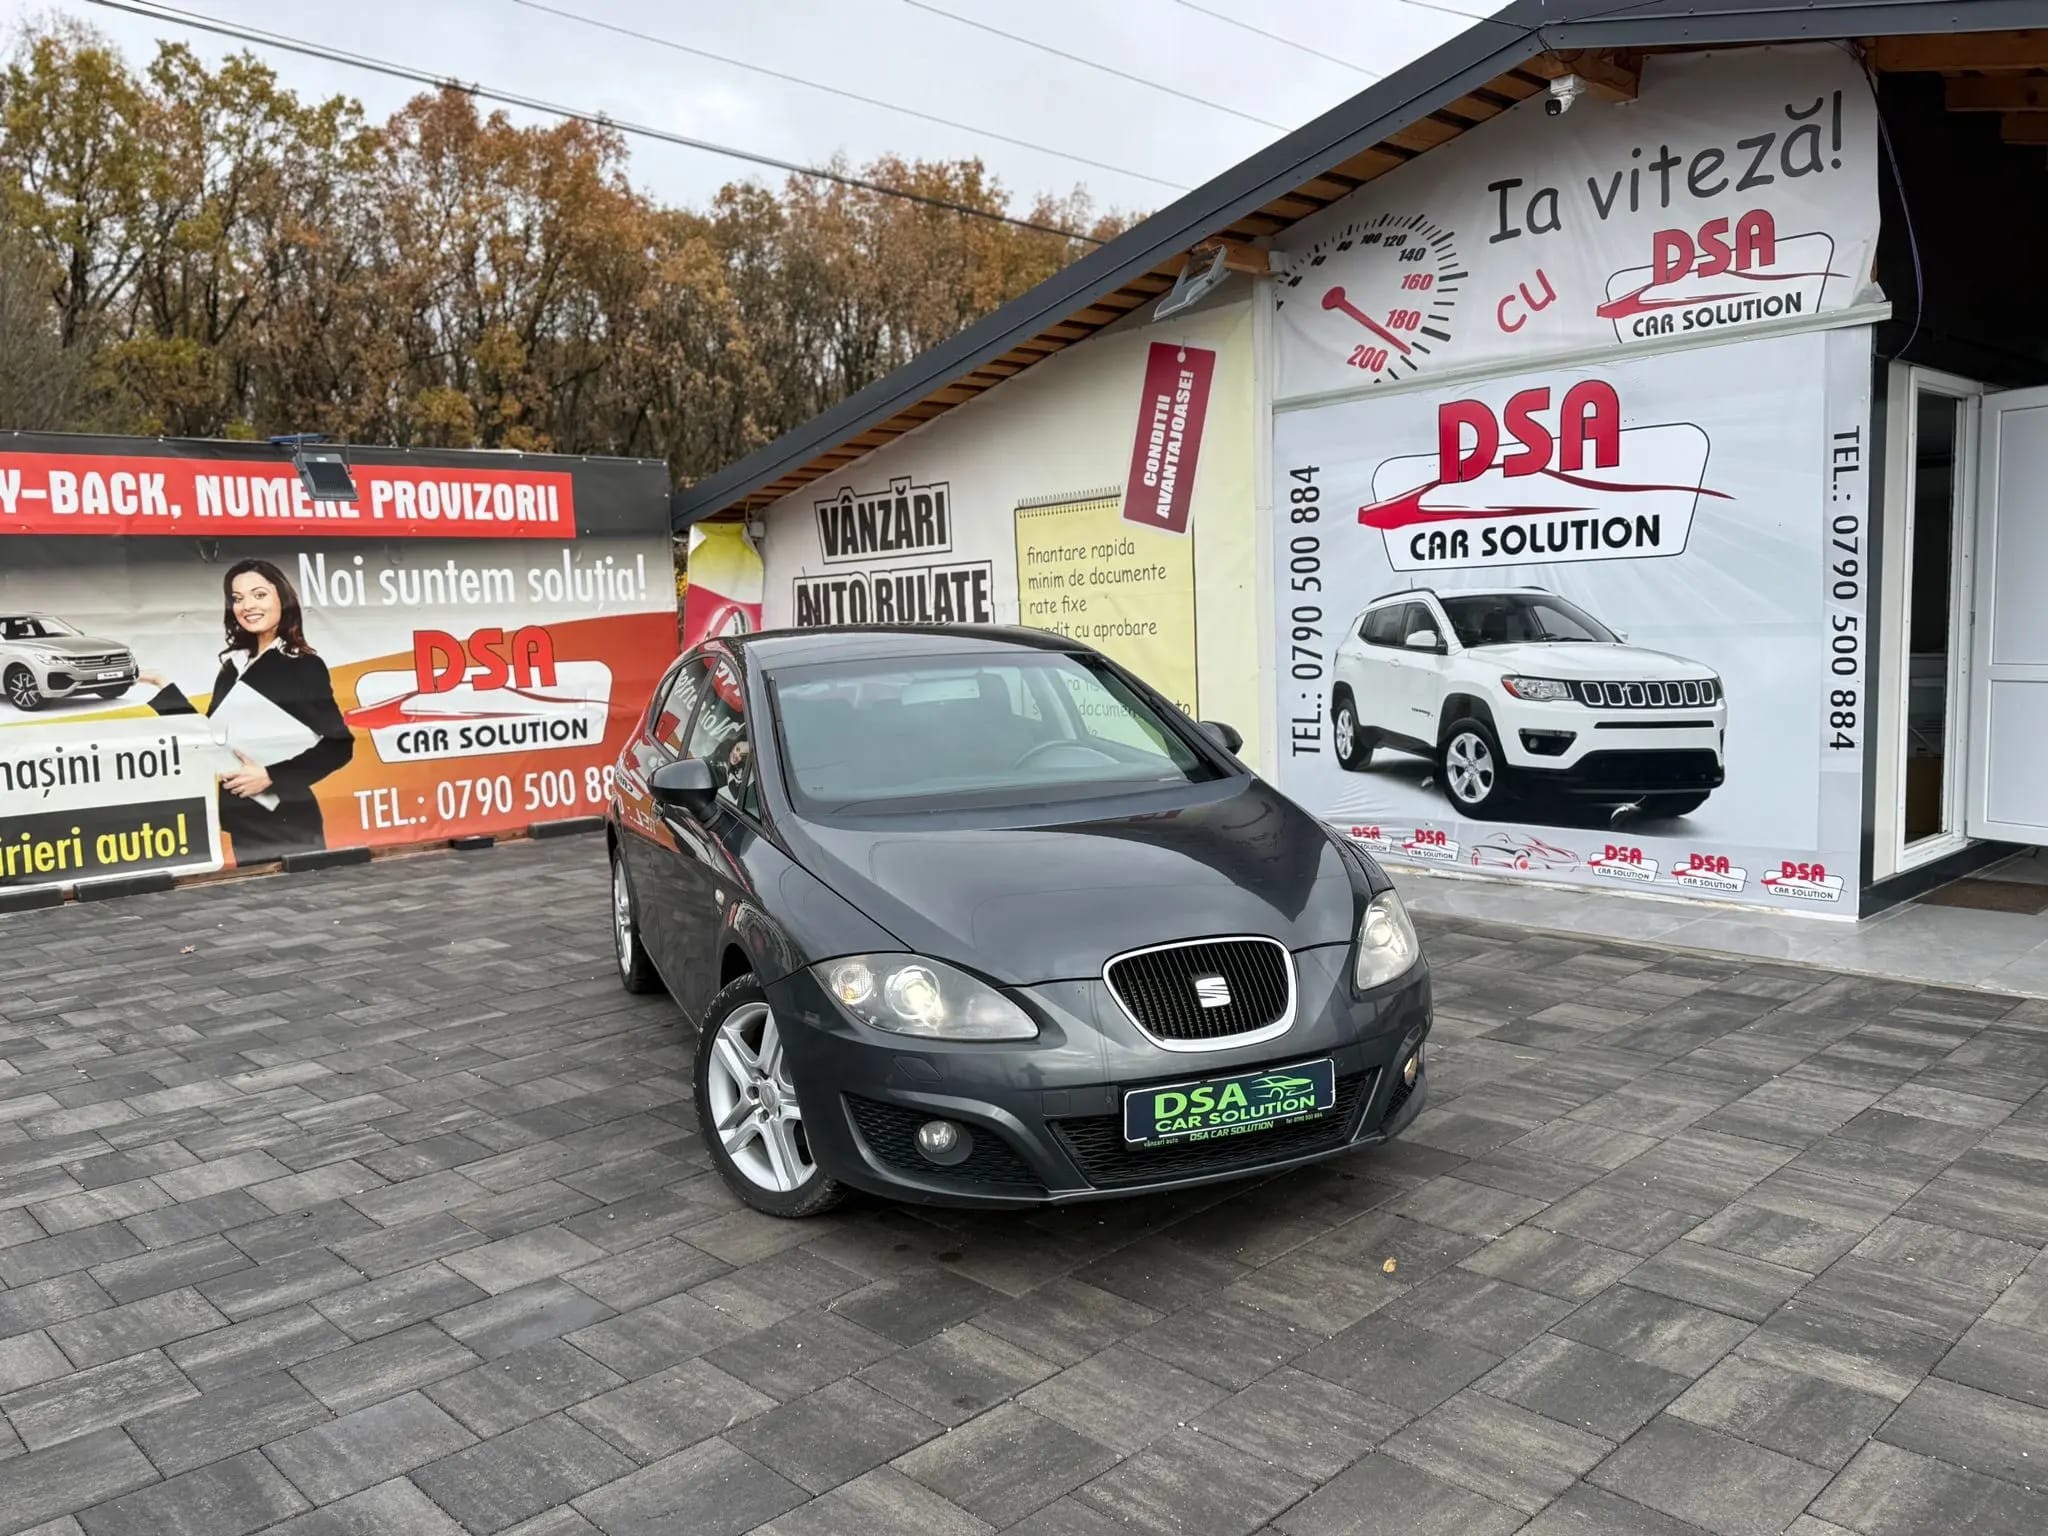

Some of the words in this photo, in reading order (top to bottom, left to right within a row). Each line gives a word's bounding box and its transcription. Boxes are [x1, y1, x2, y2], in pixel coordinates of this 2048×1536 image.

[1488, 178, 1561, 243] Ia
[1587, 90, 1842, 220] viteză!
[1360, 232, 1383, 245] 100
[1382, 234, 1408, 247] 120
[1398, 247, 1427, 262] 140
[1653, 209, 1775, 286] DSA
[1400, 273, 1434, 291] 160
[1497, 269, 1556, 333] cu
[1385, 309, 1421, 331] 180
[1632, 311, 1674, 338] CAR
[1682, 291, 1802, 330] SOLUTION
[1346, 344, 1389, 373] 200
[1143, 394, 1171, 487] CONDITII
[1156, 370, 1194, 519] AVANTAJOASE!
[1438, 379, 1620, 484] DSA
[1832, 425, 1860, 502] TEL.:
[371, 479, 559, 522] PROVIZORII
[1289, 465, 1321, 524] 884
[819, 484, 947, 557] VÂNZĂRI
[1410, 529, 1469, 561] CAR
[1482, 514, 1660, 557] SOLUTION
[1027, 545, 1086, 566] finantare
[1091, 537, 1135, 563] rapida
[1290, 535, 1322, 592] 500
[1832, 515, 1859, 601] 0790
[298, 553, 365, 607] Noi
[378, 559, 515, 605] suntem
[527, 548, 646, 611] soluția!
[875, 569, 990, 624] RULATE
[1028, 571, 1065, 590] minim
[1069, 568, 1085, 587] de
[1089, 564, 1167, 585] documente
[1029, 599, 1058, 614] rate
[1062, 595, 1088, 614] fixe
[1075, 624, 1090, 639] cu
[1094, 618, 1158, 642] aprobare
[1291, 605, 1323, 681] 0790
[1831, 614, 1858, 676] 500
[413, 625, 557, 694] DSA
[397, 728, 449, 754] CAR
[460, 718, 588, 749] SOLUTION
[1291, 692, 1323, 757] TEL.:
[1829, 689, 1857, 751] 884
[116, 735, 181, 780] noi!
[354, 787, 427, 830] TEL.:
[437, 775, 513, 820] 0790
[524, 768, 576, 811] 500
[96, 813, 189, 865] auto!
[1352, 826, 1381, 840] DSA
[1415, 829, 1447, 846] DSA
[1604, 844, 1643, 865] DSA
[1423, 850, 1454, 860] SOLUTION
[1597, 867, 1611, 875] CAR
[1613, 869, 1650, 880] SOLUTION
[1690, 853, 1730, 873] DSA
[1781, 861, 1826, 882] DSA
[1683, 877, 1697, 885] CAR
[1699, 879, 1738, 890] SOLUTION
[1774, 886, 1789, 895] CAR
[1791, 888, 1833, 899] SOLUTION
[1154, 1082, 1248, 1120] DSA
[1155, 1116, 1202, 1132] CAR
[1209, 1094, 1315, 1125] SOLUTION
[1189, 1131, 1209, 1142] DSA
[1210, 1128, 1230, 1138] CAR
[1230, 1121, 1274, 1136] SOLUTION
